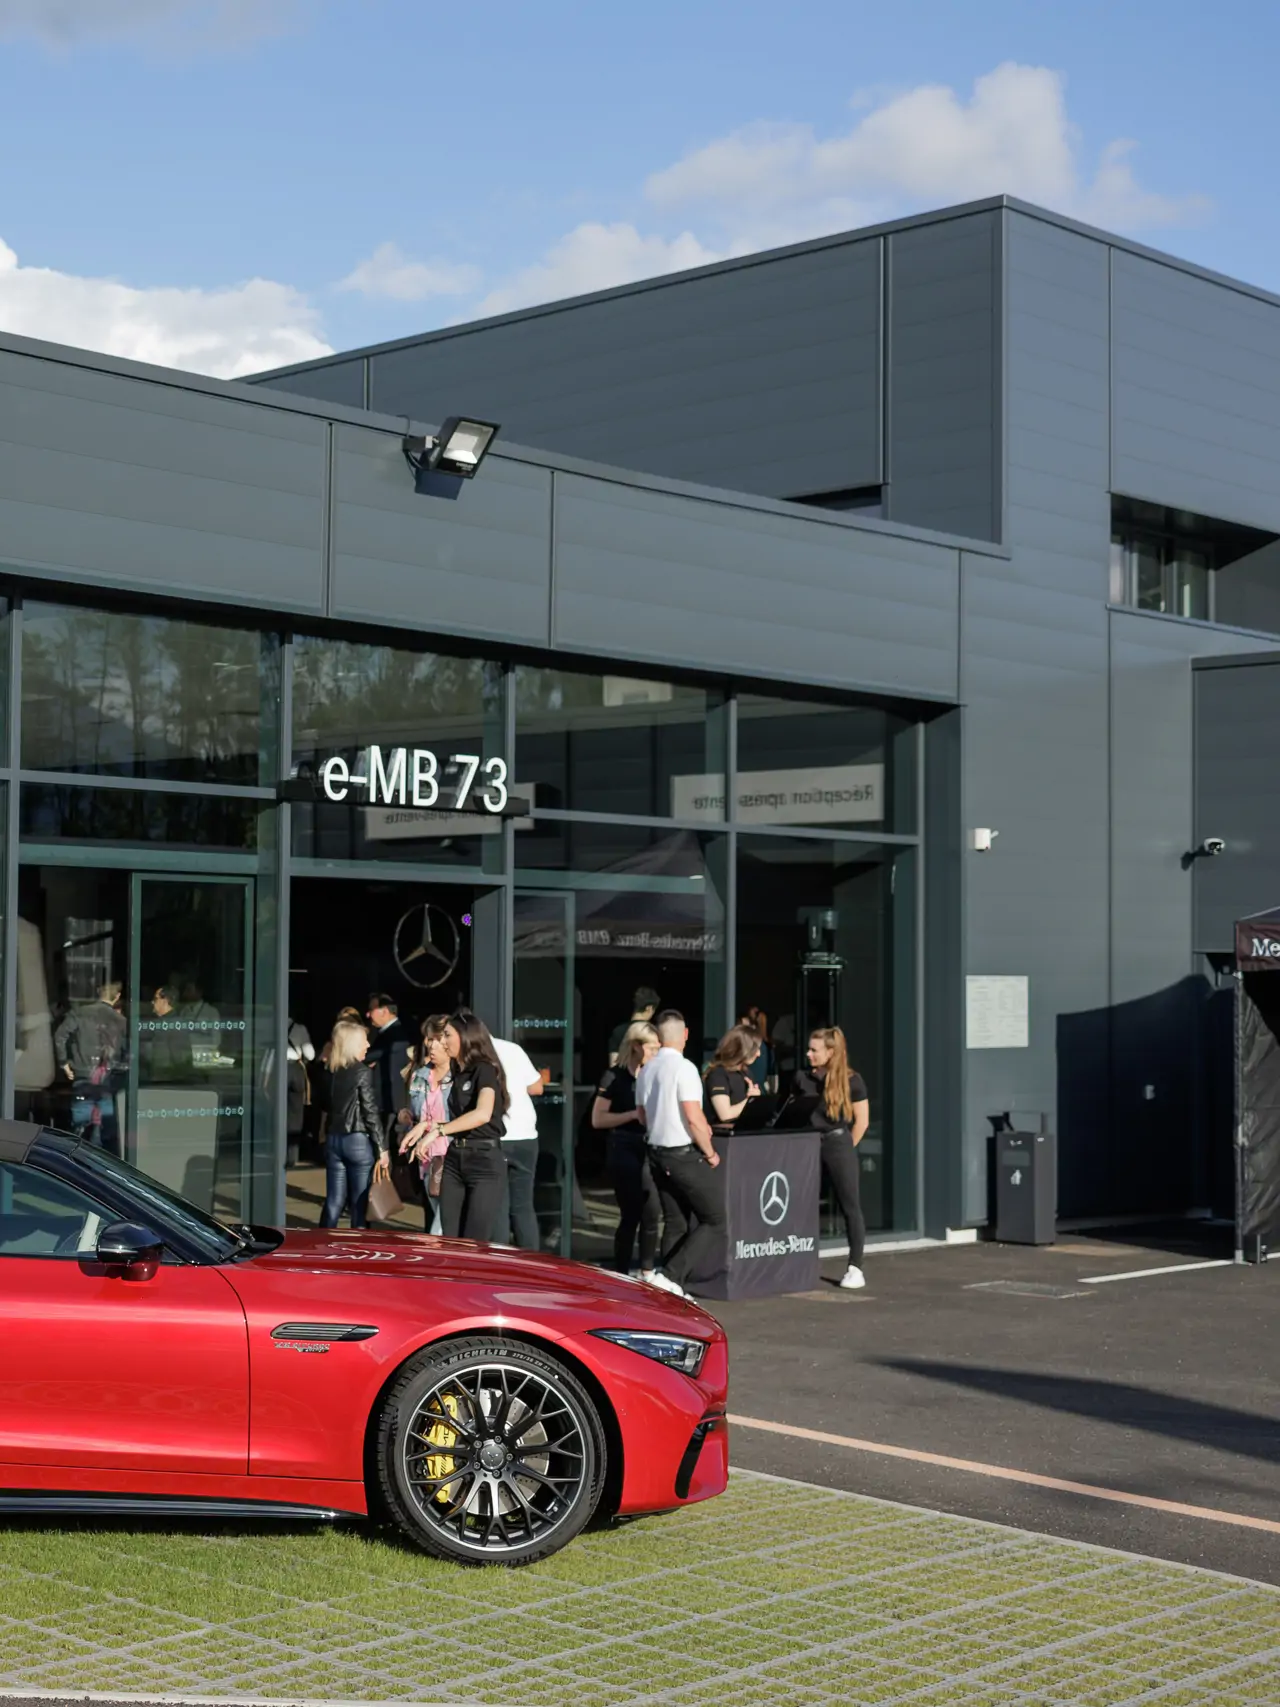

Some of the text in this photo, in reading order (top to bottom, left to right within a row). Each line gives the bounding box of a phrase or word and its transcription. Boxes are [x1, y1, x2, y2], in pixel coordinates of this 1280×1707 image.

[323, 745, 508, 813] e-MB 73
[448, 1350, 508, 1365] MICHELIN
